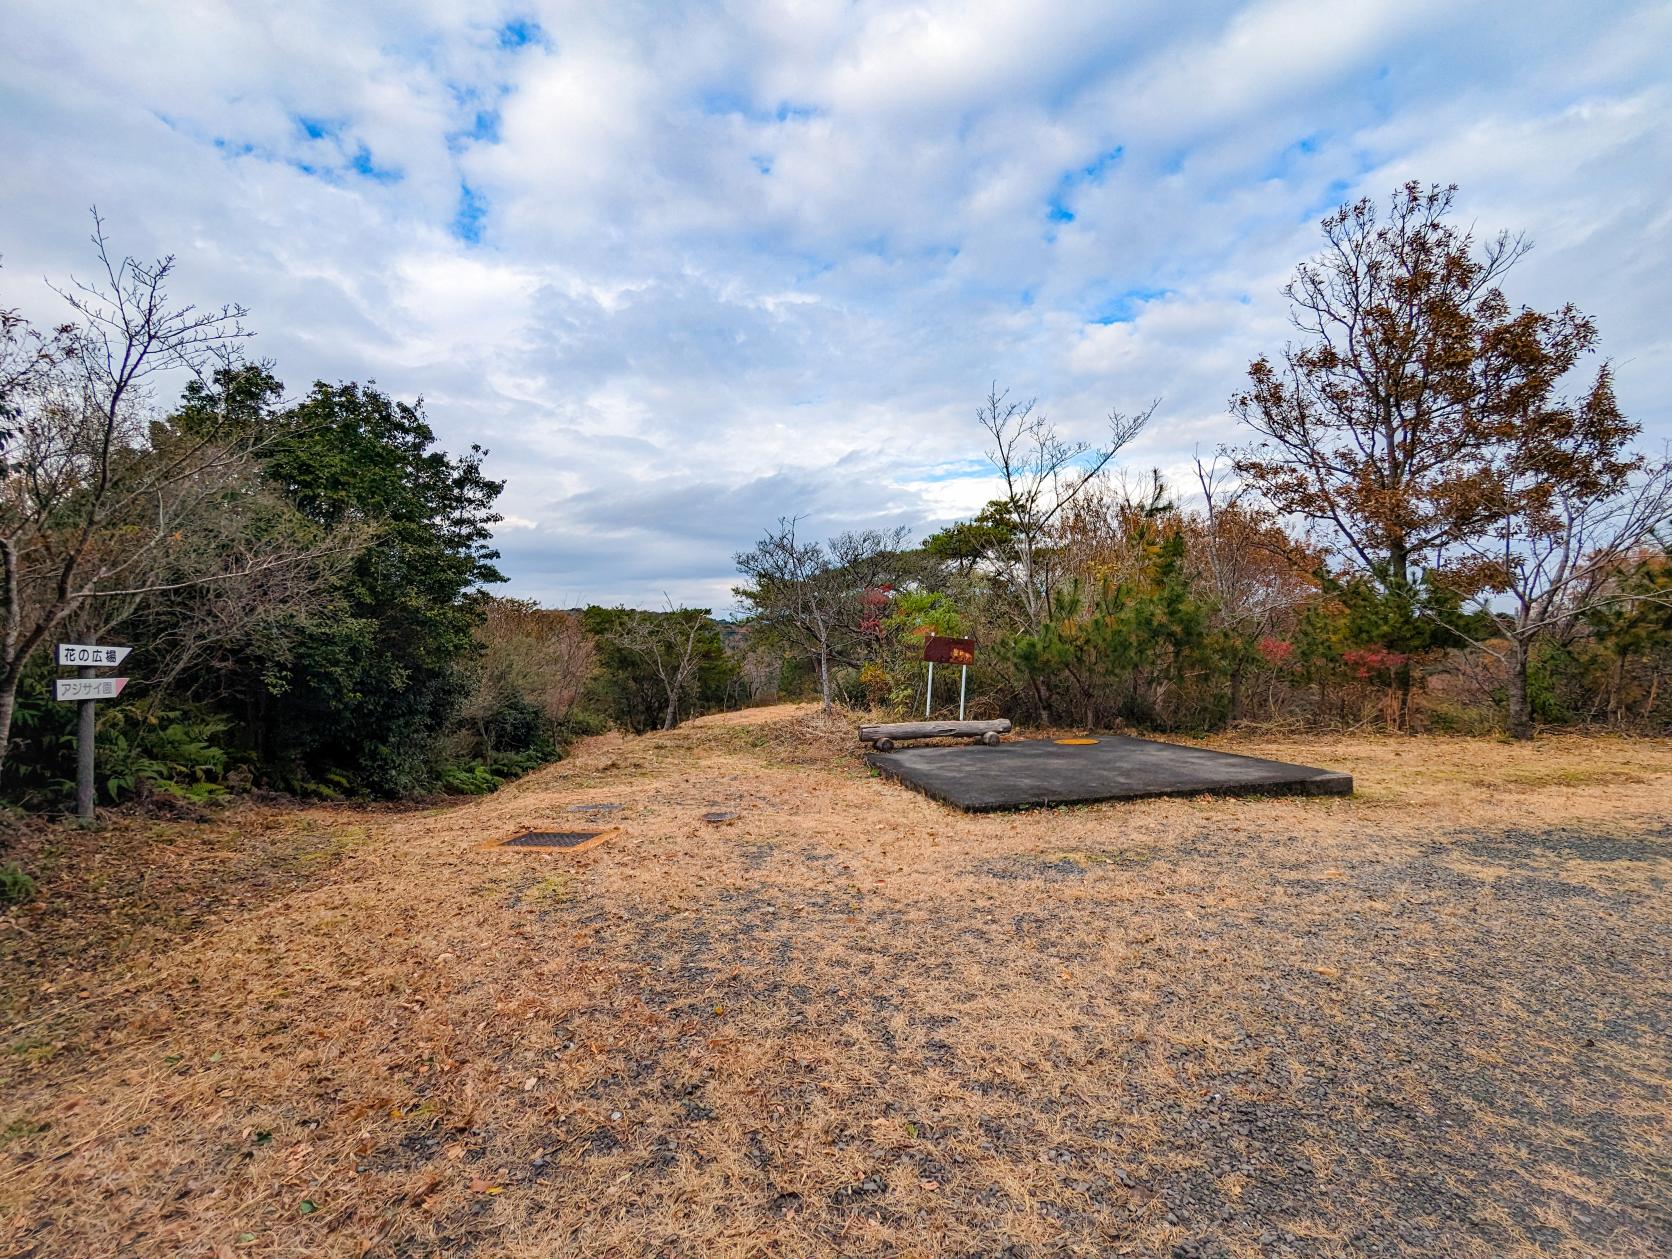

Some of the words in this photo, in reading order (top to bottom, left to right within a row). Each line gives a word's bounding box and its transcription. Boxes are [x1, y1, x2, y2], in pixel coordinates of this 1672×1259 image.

[65, 648, 116, 663] 花の広場
[61, 681, 112, 696] アジサイ園
